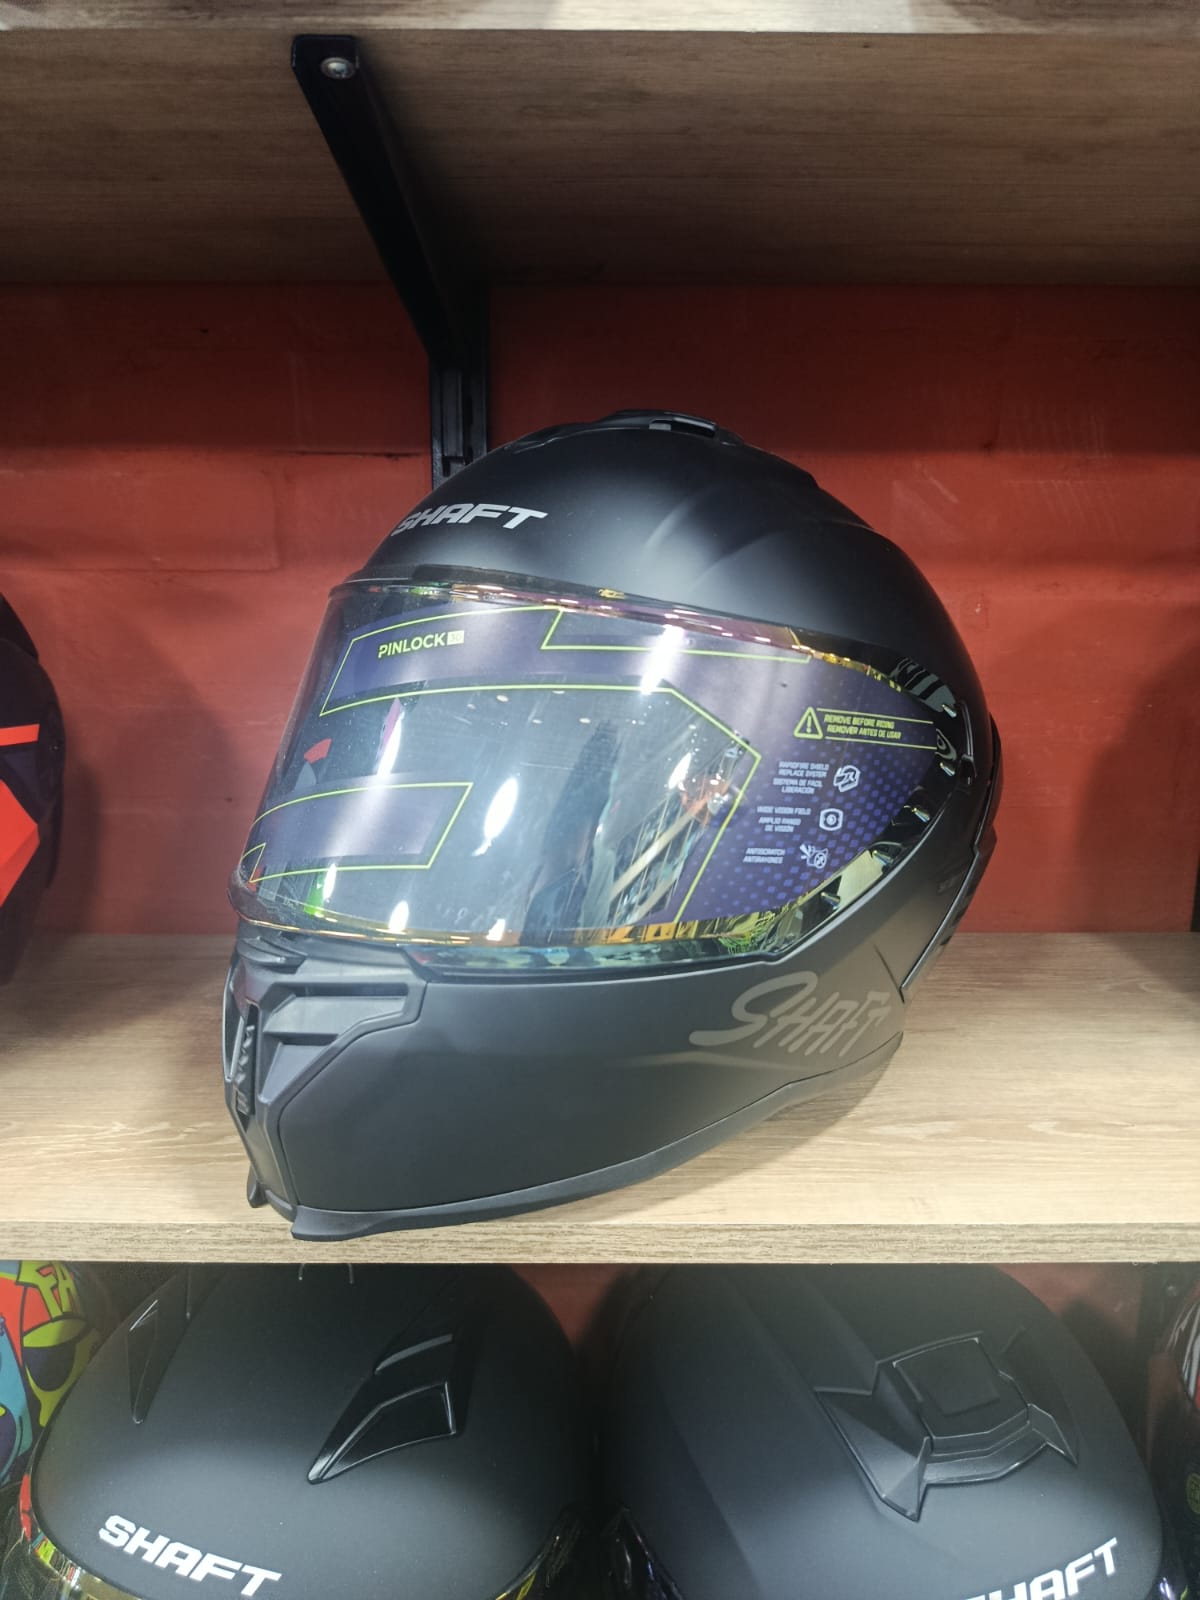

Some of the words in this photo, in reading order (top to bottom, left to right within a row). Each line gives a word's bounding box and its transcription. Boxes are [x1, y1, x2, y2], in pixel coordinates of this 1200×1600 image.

[391, 503, 548, 537] SHAFT
[378, 632, 446, 658] PINLOCK
[824, 714, 851, 725] REMOVE
[852, 716, 876, 727] BEFORE
[827, 724, 858, 735] REMOVER
[859, 727, 878, 737] ANTES
[878, 729, 886, 738] DE
[886, 731, 902, 740] USAR
[99, 1515, 282, 1597] SHAFT
[965, 1537, 1117, 1600] AFT
